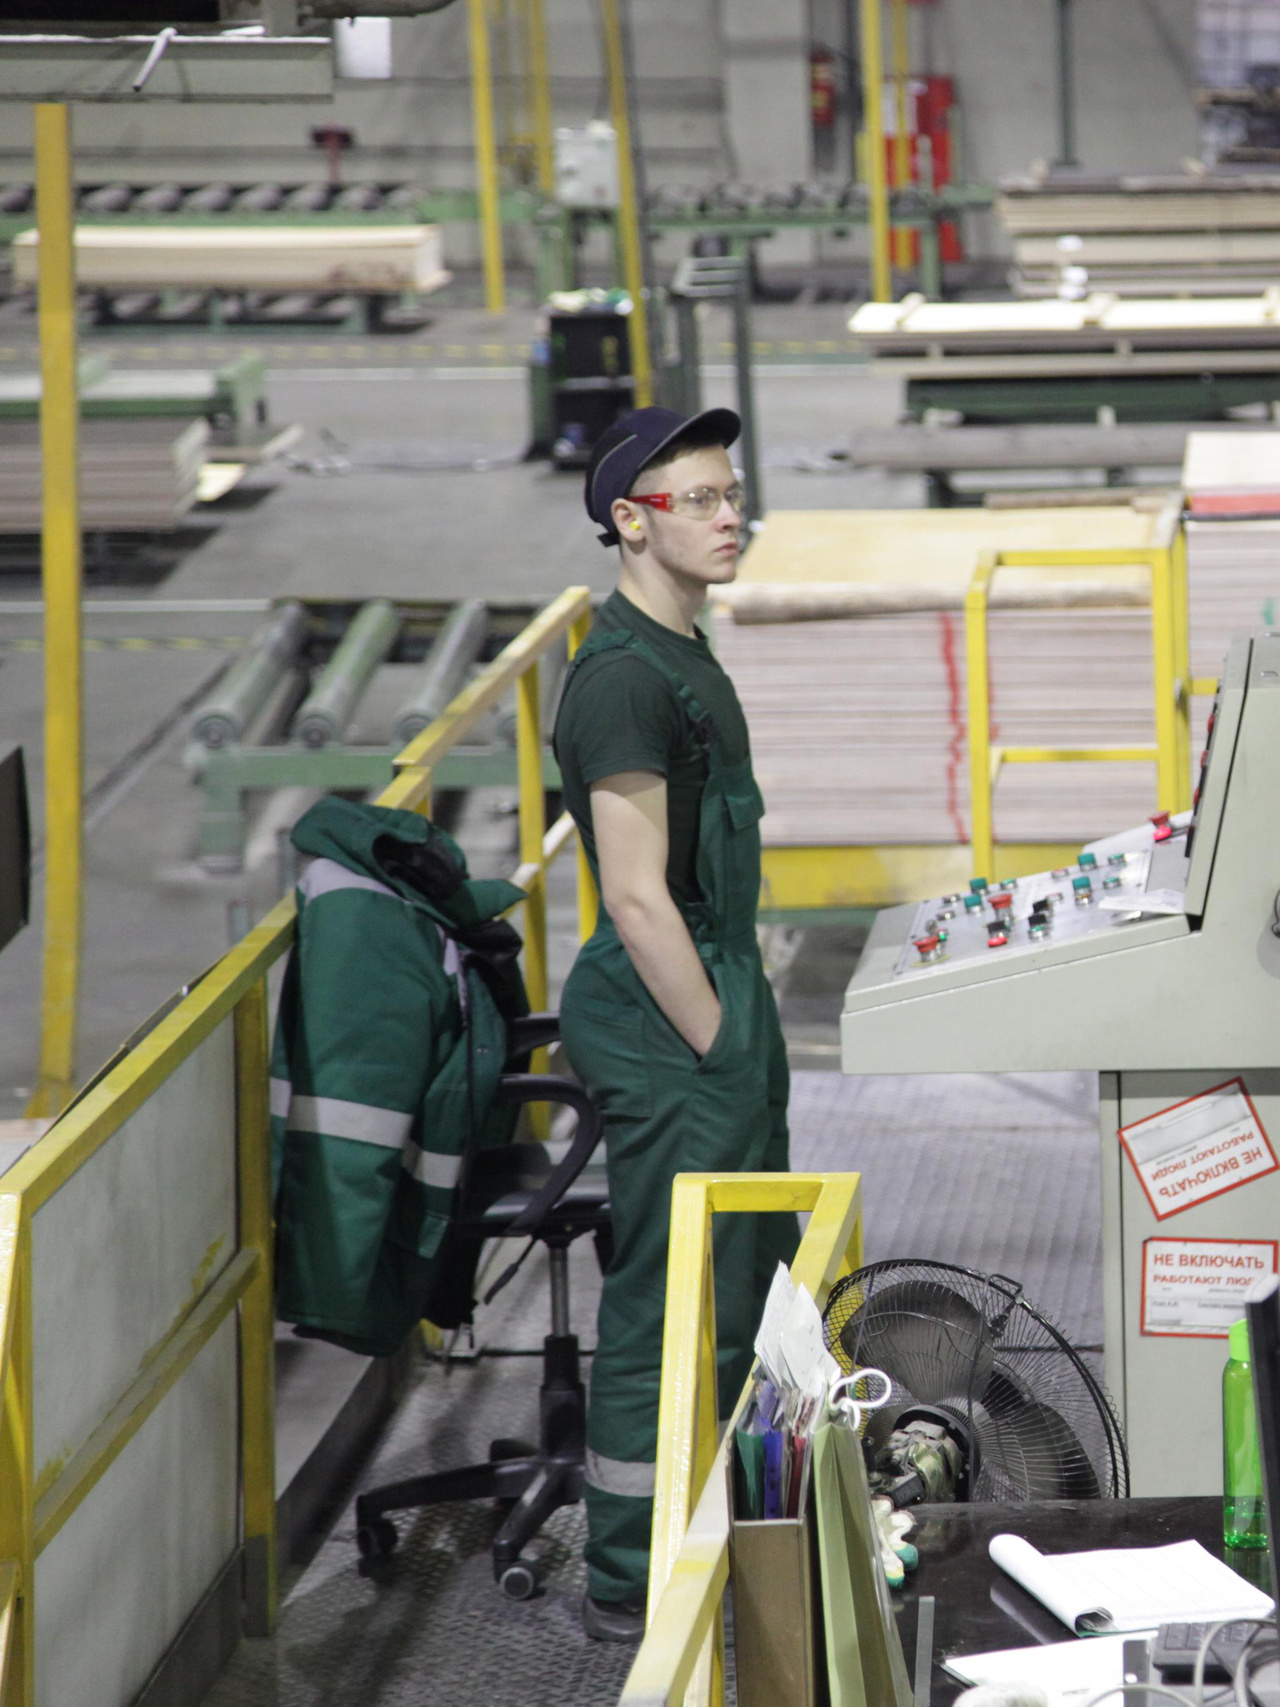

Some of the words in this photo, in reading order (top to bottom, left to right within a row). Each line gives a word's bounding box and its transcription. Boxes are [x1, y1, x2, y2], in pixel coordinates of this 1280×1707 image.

[1190, 1130, 1255, 1165] РАБОТАЮТ
[1241, 1146, 1263, 1165] НЕ
[1151, 1160, 1187, 1181] ЛЮДИ
[1159, 1156, 1240, 1198] ВКЛЮЧАТЬ
[1153, 1253, 1174, 1267] НЕ
[1178, 1253, 1265, 1269] ВКЛЮЧАТЬ
[1152, 1273, 1223, 1285] РАБОТАЮТ
[1225, 1275, 1254, 1287] ЛЮД
